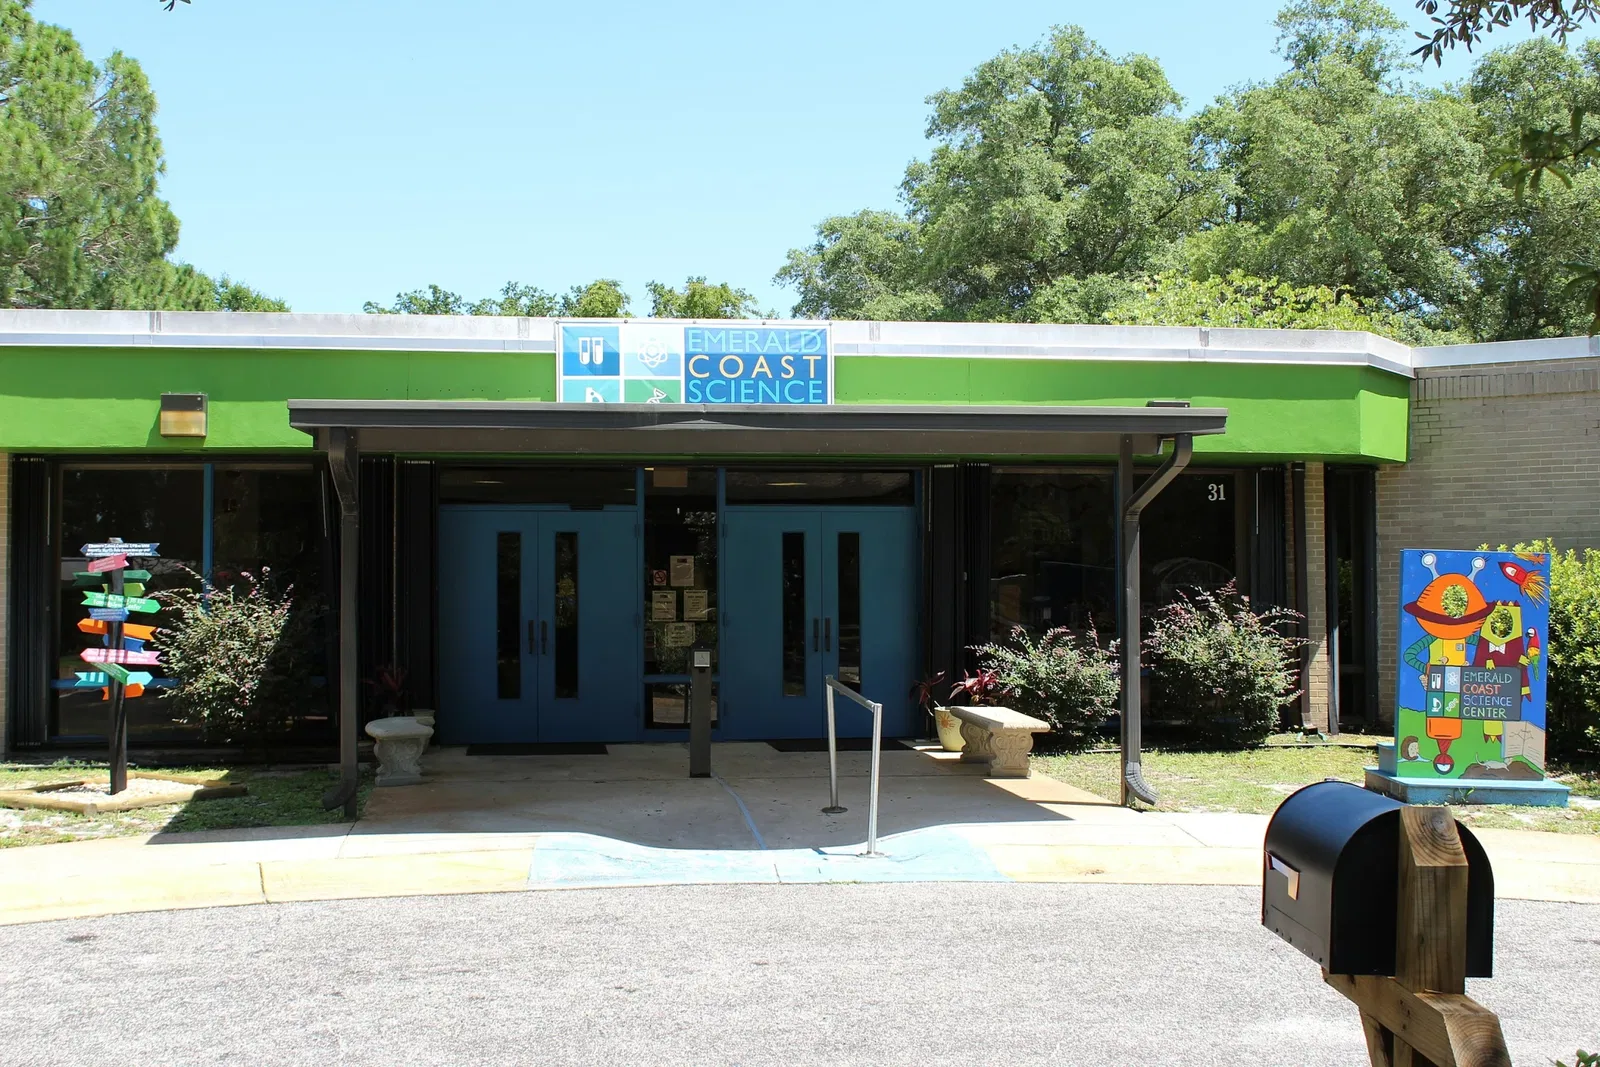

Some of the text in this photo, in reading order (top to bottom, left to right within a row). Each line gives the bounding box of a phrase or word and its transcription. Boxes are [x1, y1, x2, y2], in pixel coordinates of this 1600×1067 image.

[688, 330, 822, 353] EMERALD
[688, 354, 822, 379] COAST
[688, 379, 823, 404] SCIENCE
[1208, 483, 1226, 501] 31
[1463, 671, 1512, 683] EMERALD
[1463, 684, 1501, 695] COAST
[1463, 695, 1512, 706] SCIENCE
[1463, 707, 1507, 718] CENTER
